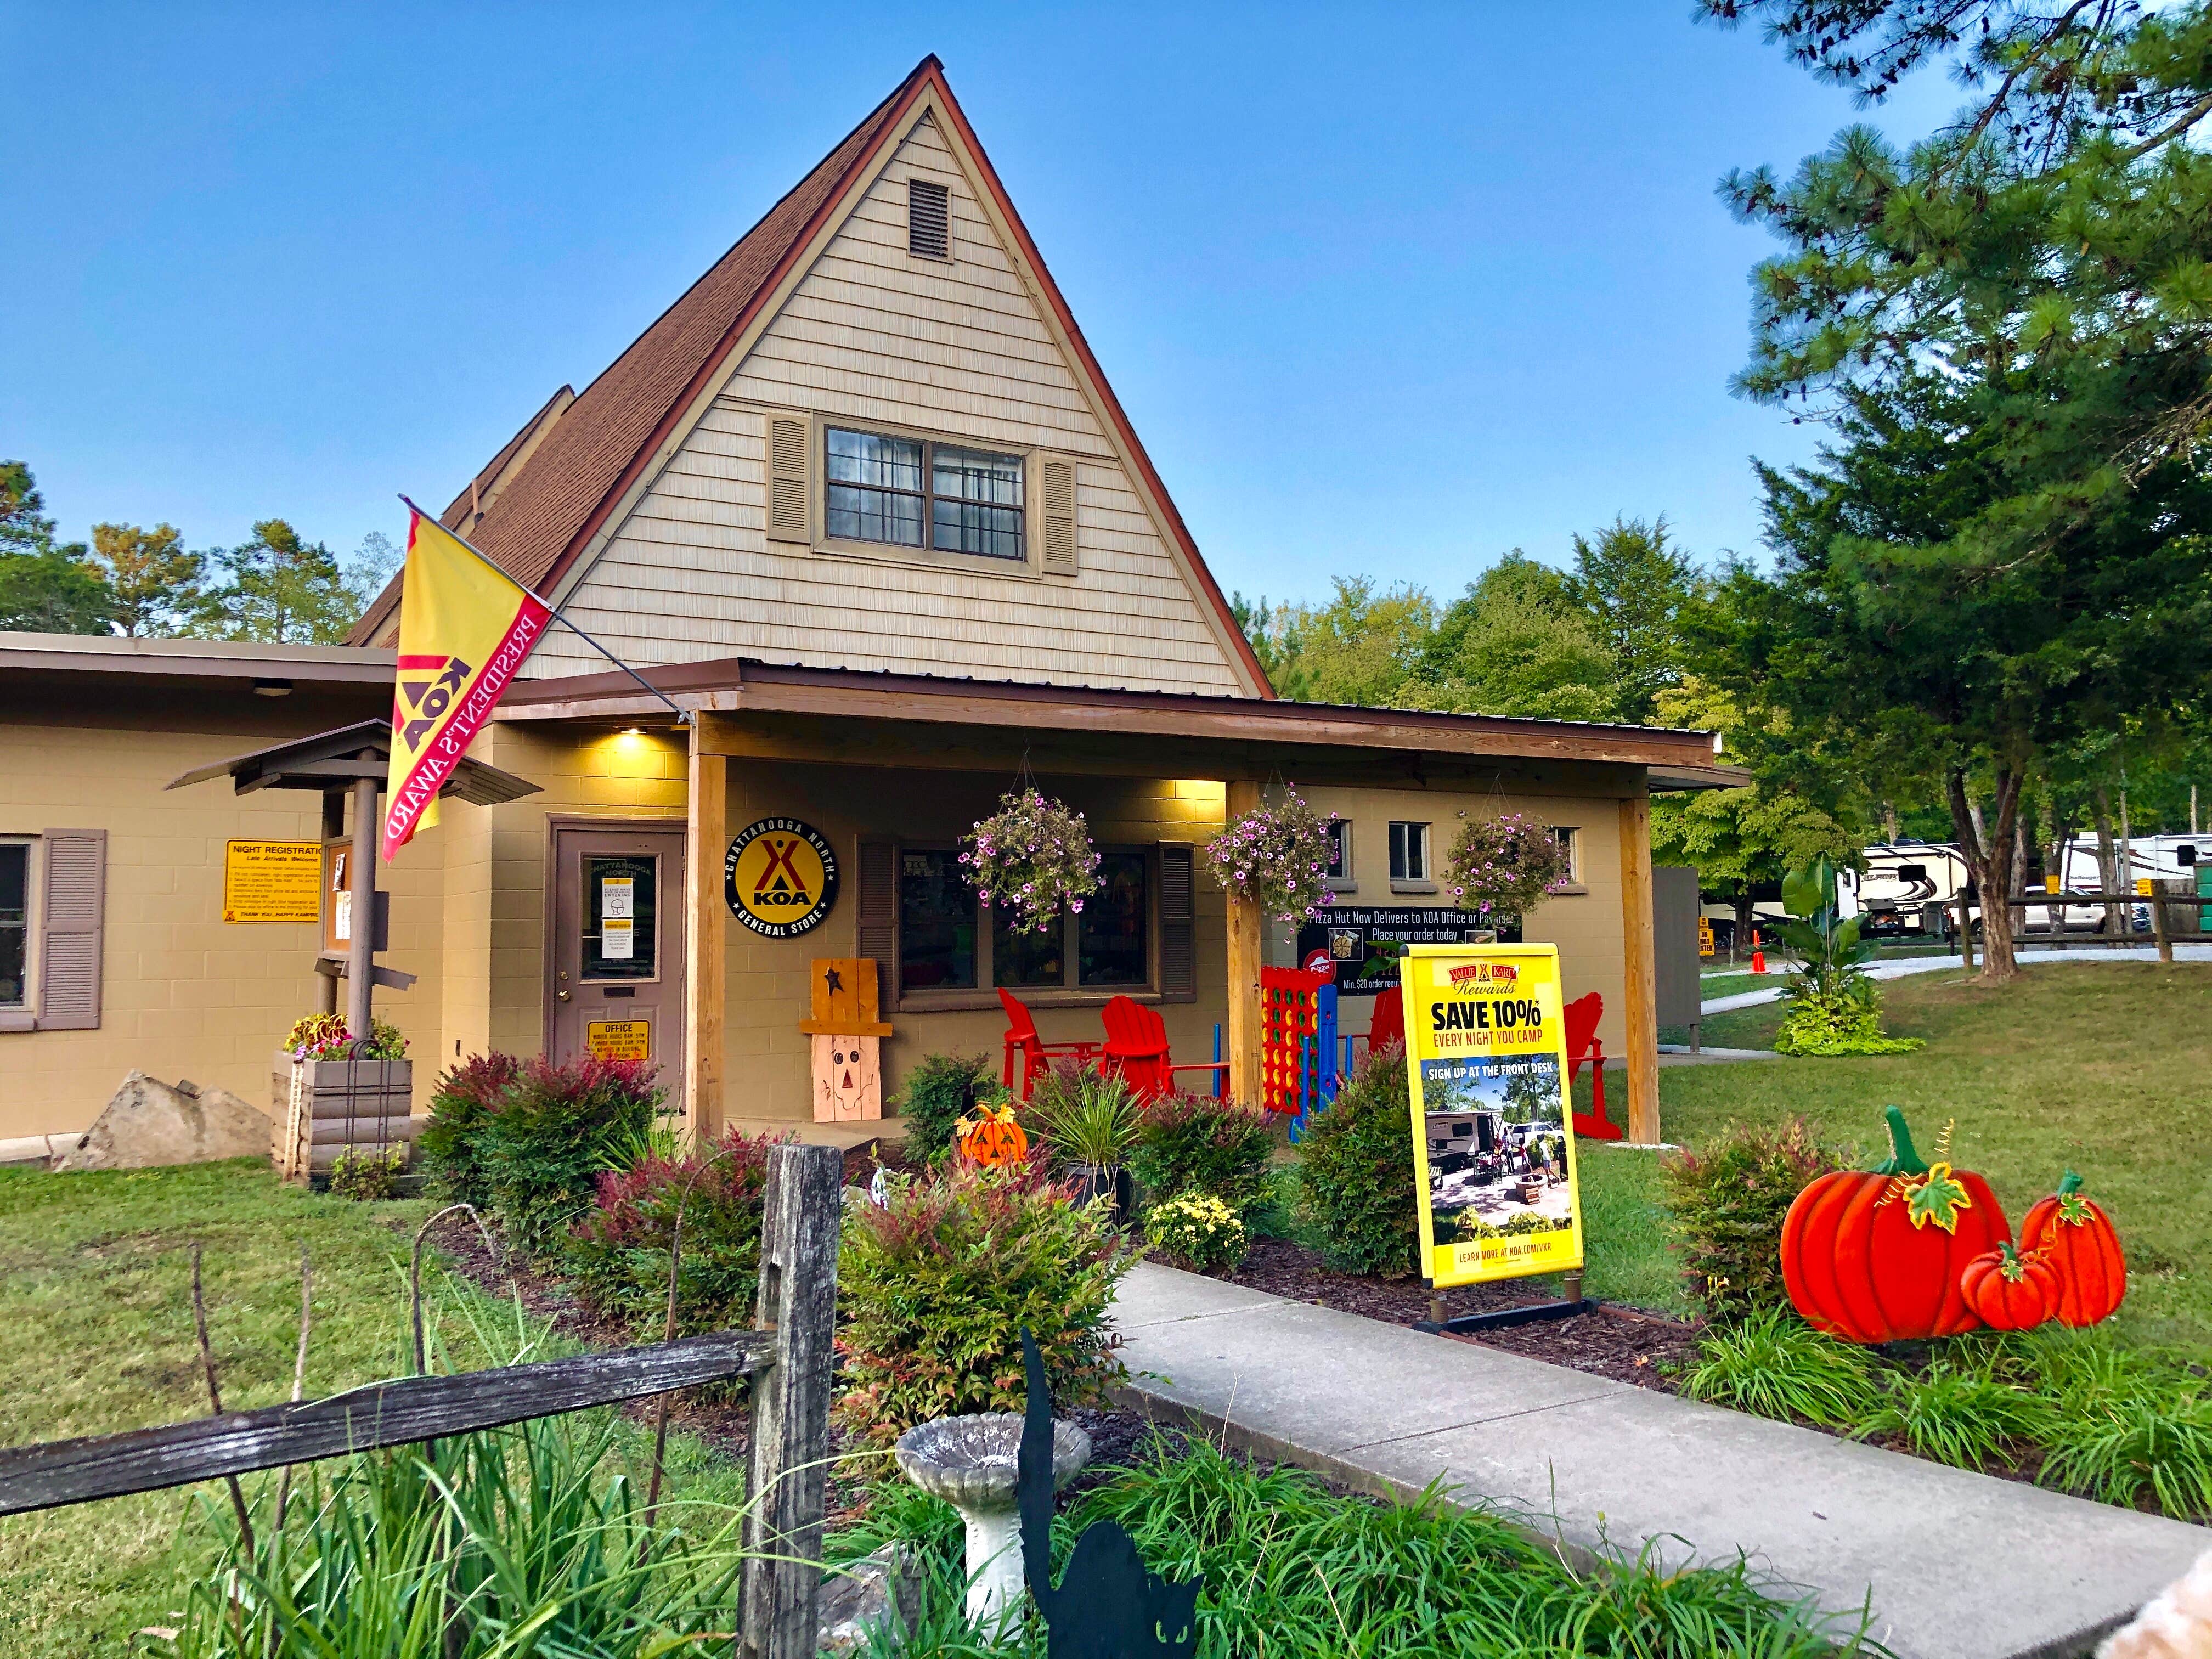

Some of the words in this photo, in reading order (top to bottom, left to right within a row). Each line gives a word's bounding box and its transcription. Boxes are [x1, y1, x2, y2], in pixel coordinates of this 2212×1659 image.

[265, 847, 321, 855] REGISTRATIO
[725, 820, 802, 871] CHATTANOOGA
[809, 832, 834, 872] NORTH
[754, 891, 812, 906] KOA
[738, 910, 785, 936] GENERAL
[791, 909, 822, 934] STORE
[1335, 911, 1350, 924] Hut
[1353, 911, 1372, 924] Now
[1374, 911, 1409, 924] Delivers
[1412, 912, 1420, 924] to
[1423, 911, 1439, 924] KOA
[1441, 911, 1466, 924] Office
[1469, 915, 1477, 924] or
[1373, 928, 1393, 940] Place
[1395, 932, 1412, 941] your
[1414, 928, 1434, 940] order
[1437, 928, 1457, 942] today
[1451, 967, 1476, 979] VALUE
[1493, 966, 1515, 978] KARD
[1344, 980, 1355, 989] Min.
[1357, 979, 1368, 989] $20
[1368, 979, 1381, 988] order
[1385, 979, 1401, 988] requir
[1453, 978, 1515, 995] Rewards
[1431, 1001, 1489, 1030] SAVE
[605, 1024, 633, 1032] OFFICE
[1434, 1032, 1463, 1048] EVERY
[1466, 1031, 1494, 1046] NIGHT
[1497, 1030, 1514, 1044] YOU
[1517, 1029, 1543, 1043] CAMP
[1429, 1068, 1451, 1080] SIGN
[1455, 1066, 1466, 1079] UP
[1469, 1066, 1480, 1077] AT
[1482, 1065, 1499, 1076] THE
[1500, 1063, 1528, 1075] FRONT
[1531, 1062, 1553, 1074] DESK
[1459, 1252, 1480, 1263] LEARN
[1481, 1249, 1499, 1260] MORE
[1500, 1248, 1508, 1257] AT
[1510, 1242, 1551, 1256] KOA.COM/VKR
